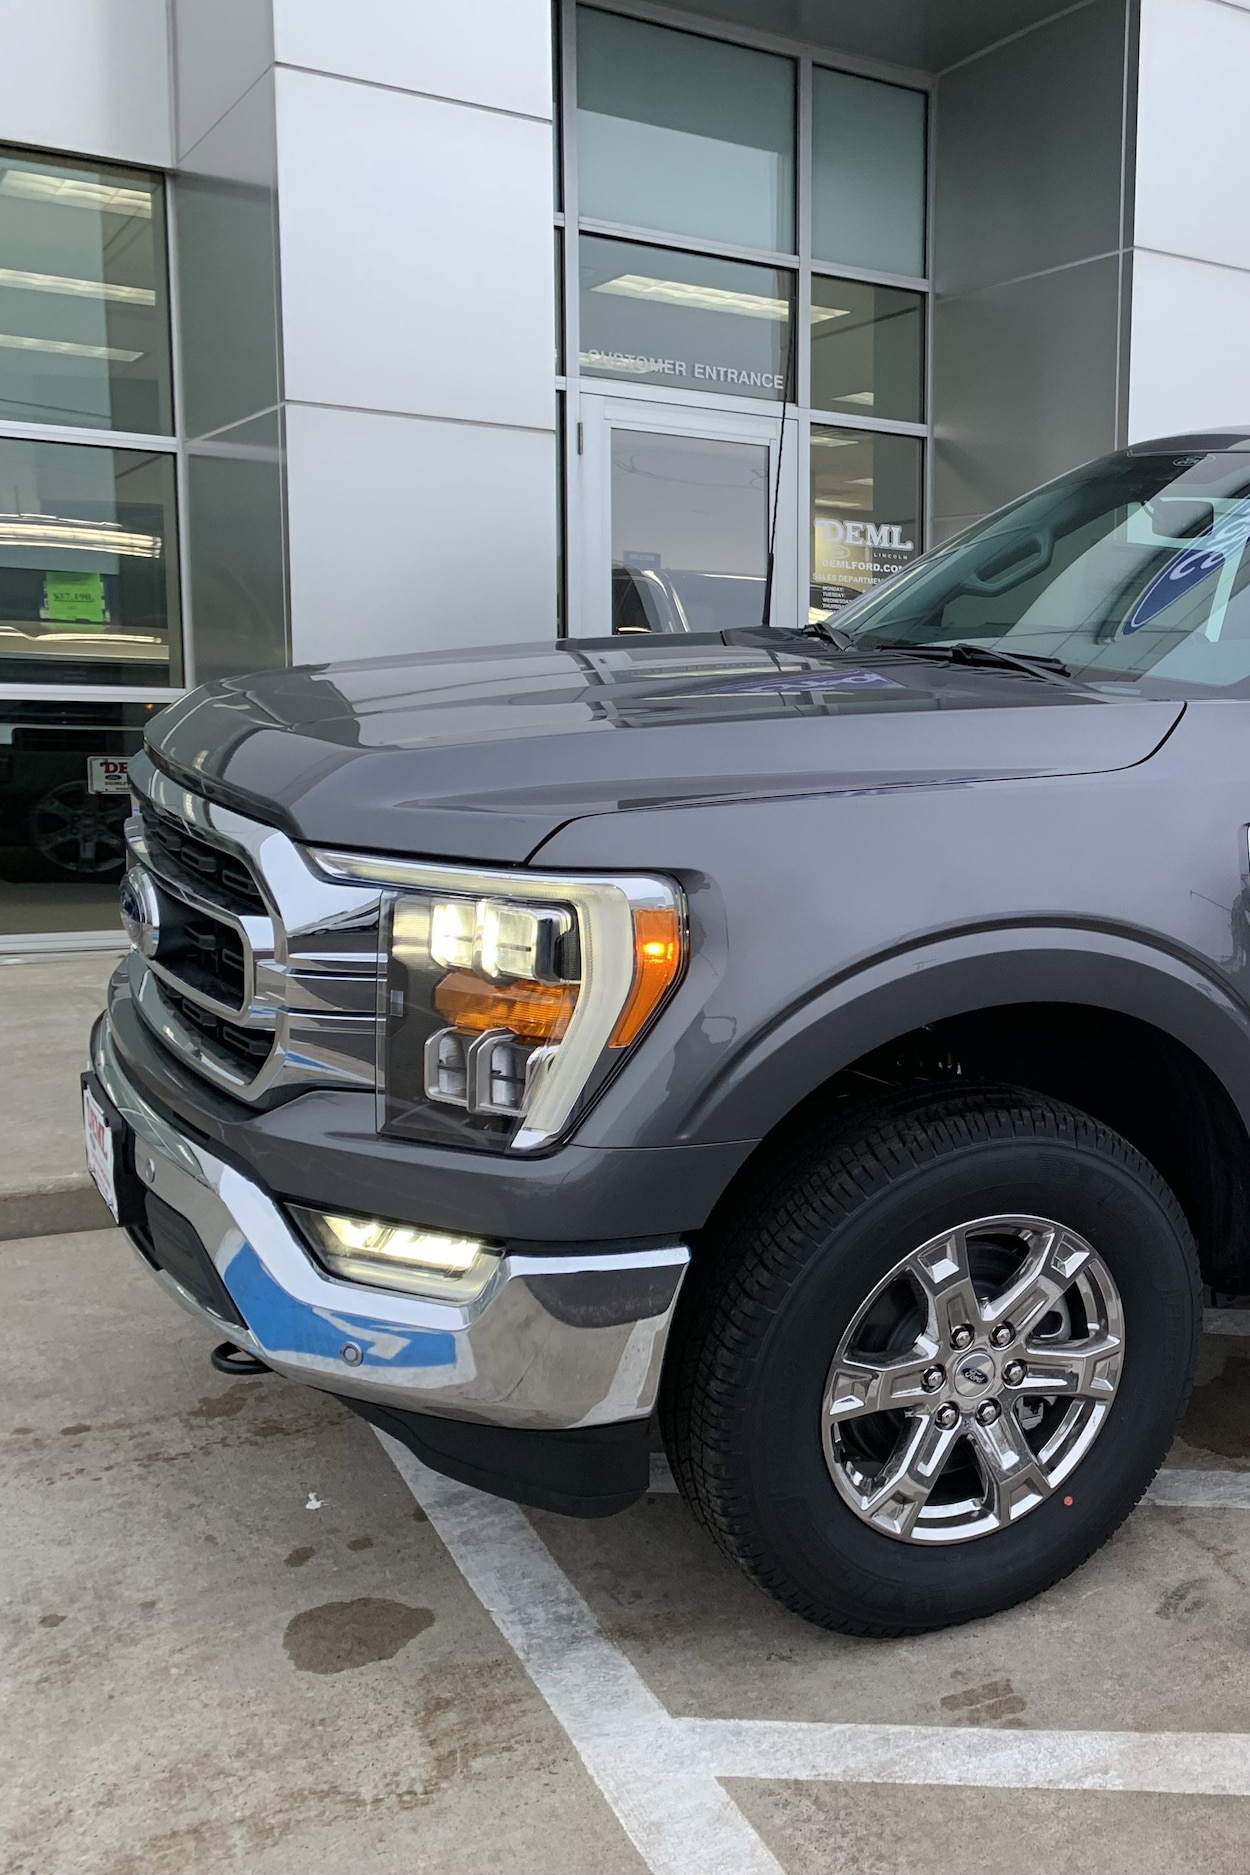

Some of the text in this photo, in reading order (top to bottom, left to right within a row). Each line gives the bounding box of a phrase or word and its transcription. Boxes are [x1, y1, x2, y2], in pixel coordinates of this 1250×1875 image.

[587, 349, 784, 389] CUSTOMER ENTRANCE
[813, 518, 914, 551] DEML
[873, 552, 908, 560] LINCOLN
[813, 573, 836, 581] SALES
[964, 1368, 987, 1384] Ford
